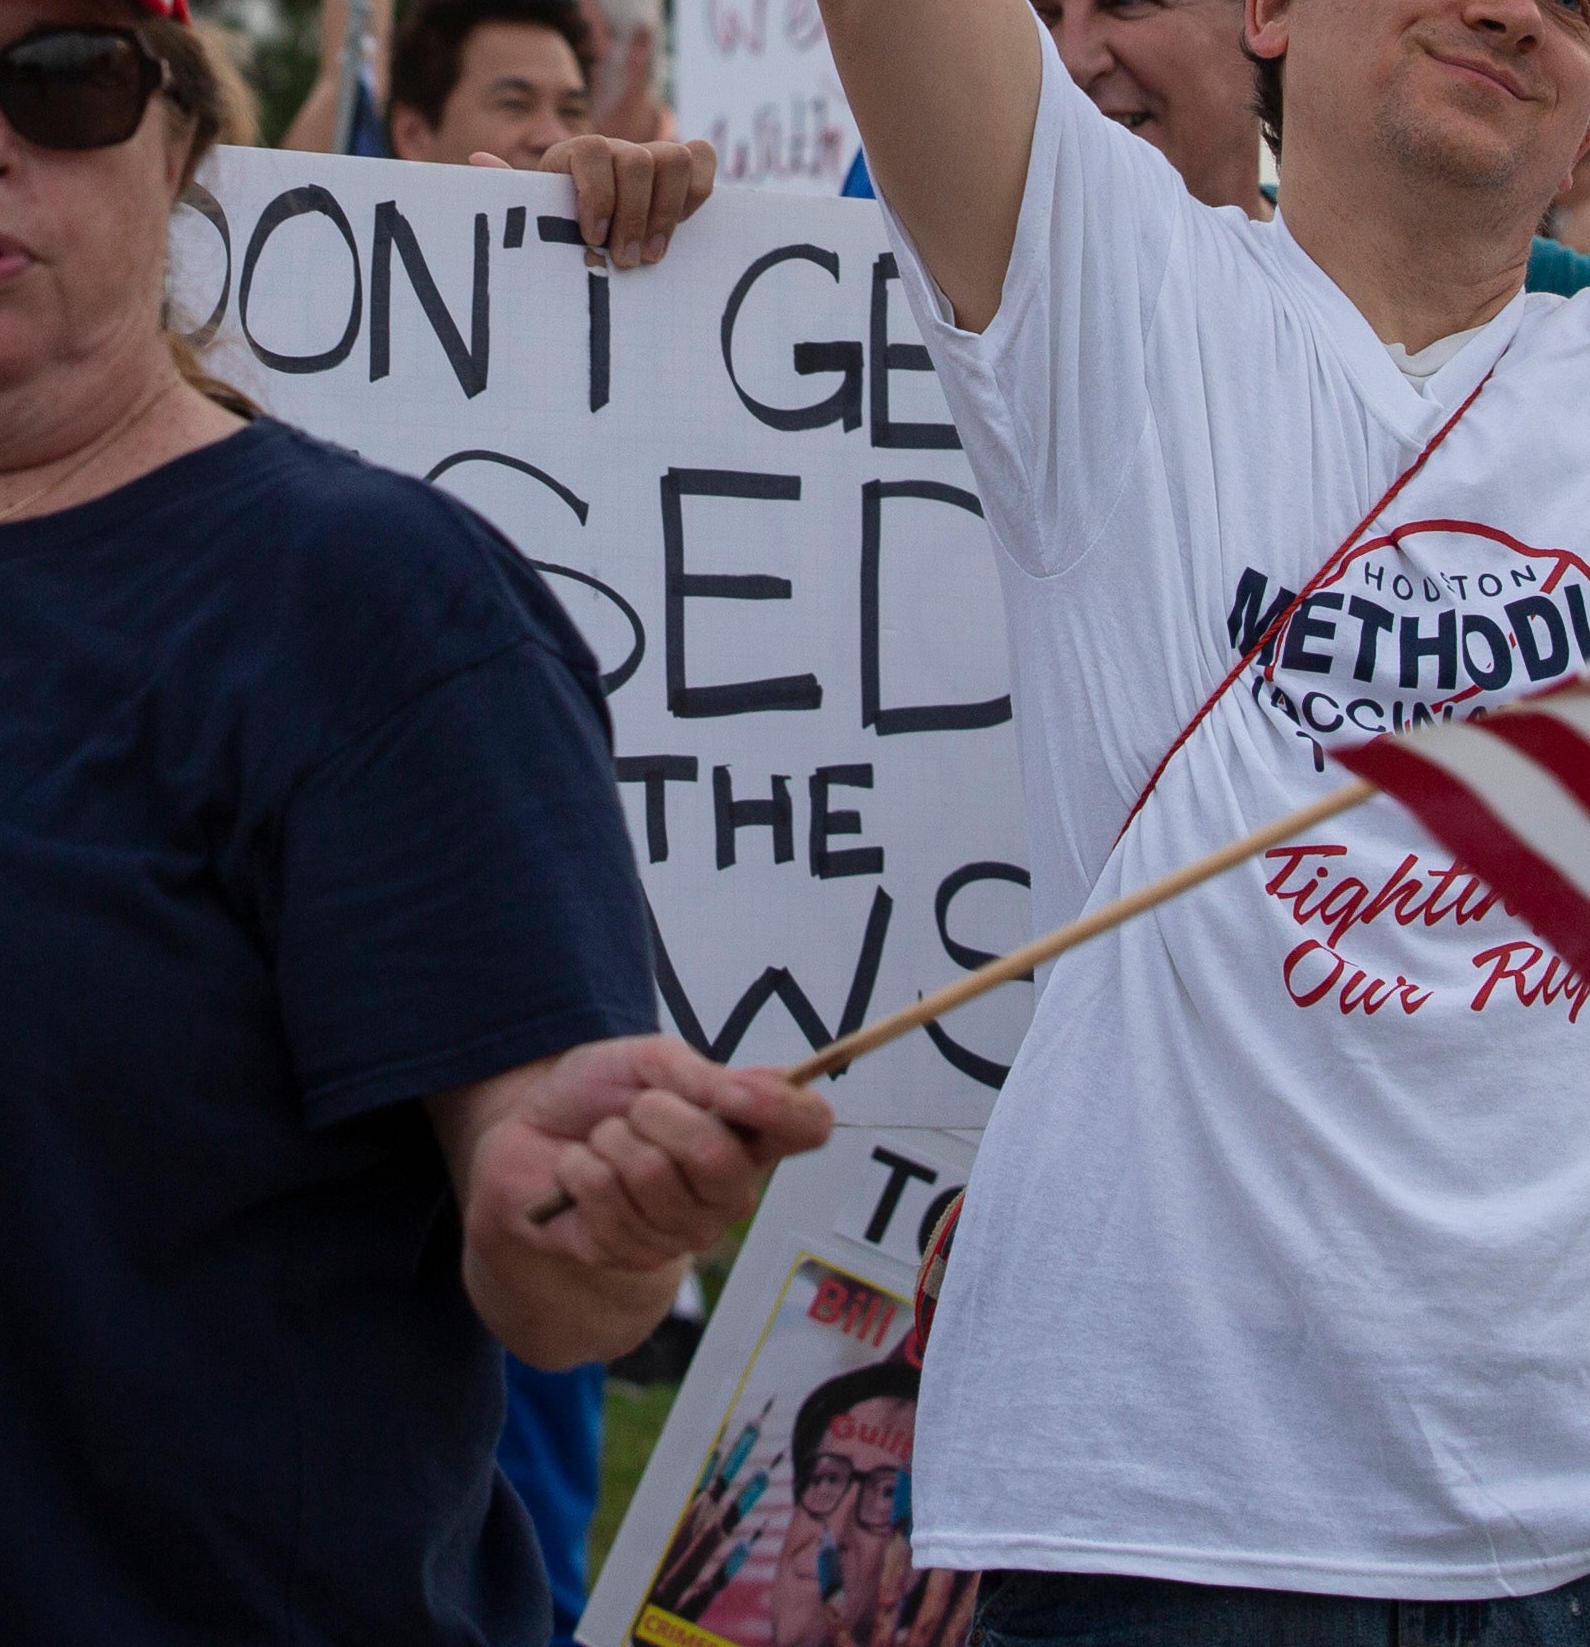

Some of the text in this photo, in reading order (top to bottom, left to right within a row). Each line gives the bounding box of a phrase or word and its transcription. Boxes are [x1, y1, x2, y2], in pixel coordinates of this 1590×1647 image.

[720, 243, 965, 448] GE
[615, 756, 884, 879] THE
[1283, 938, 1435, 1015] Our
[808, 1277, 897, 1349] Bill
[829, 1412, 914, 1462] Guilt
